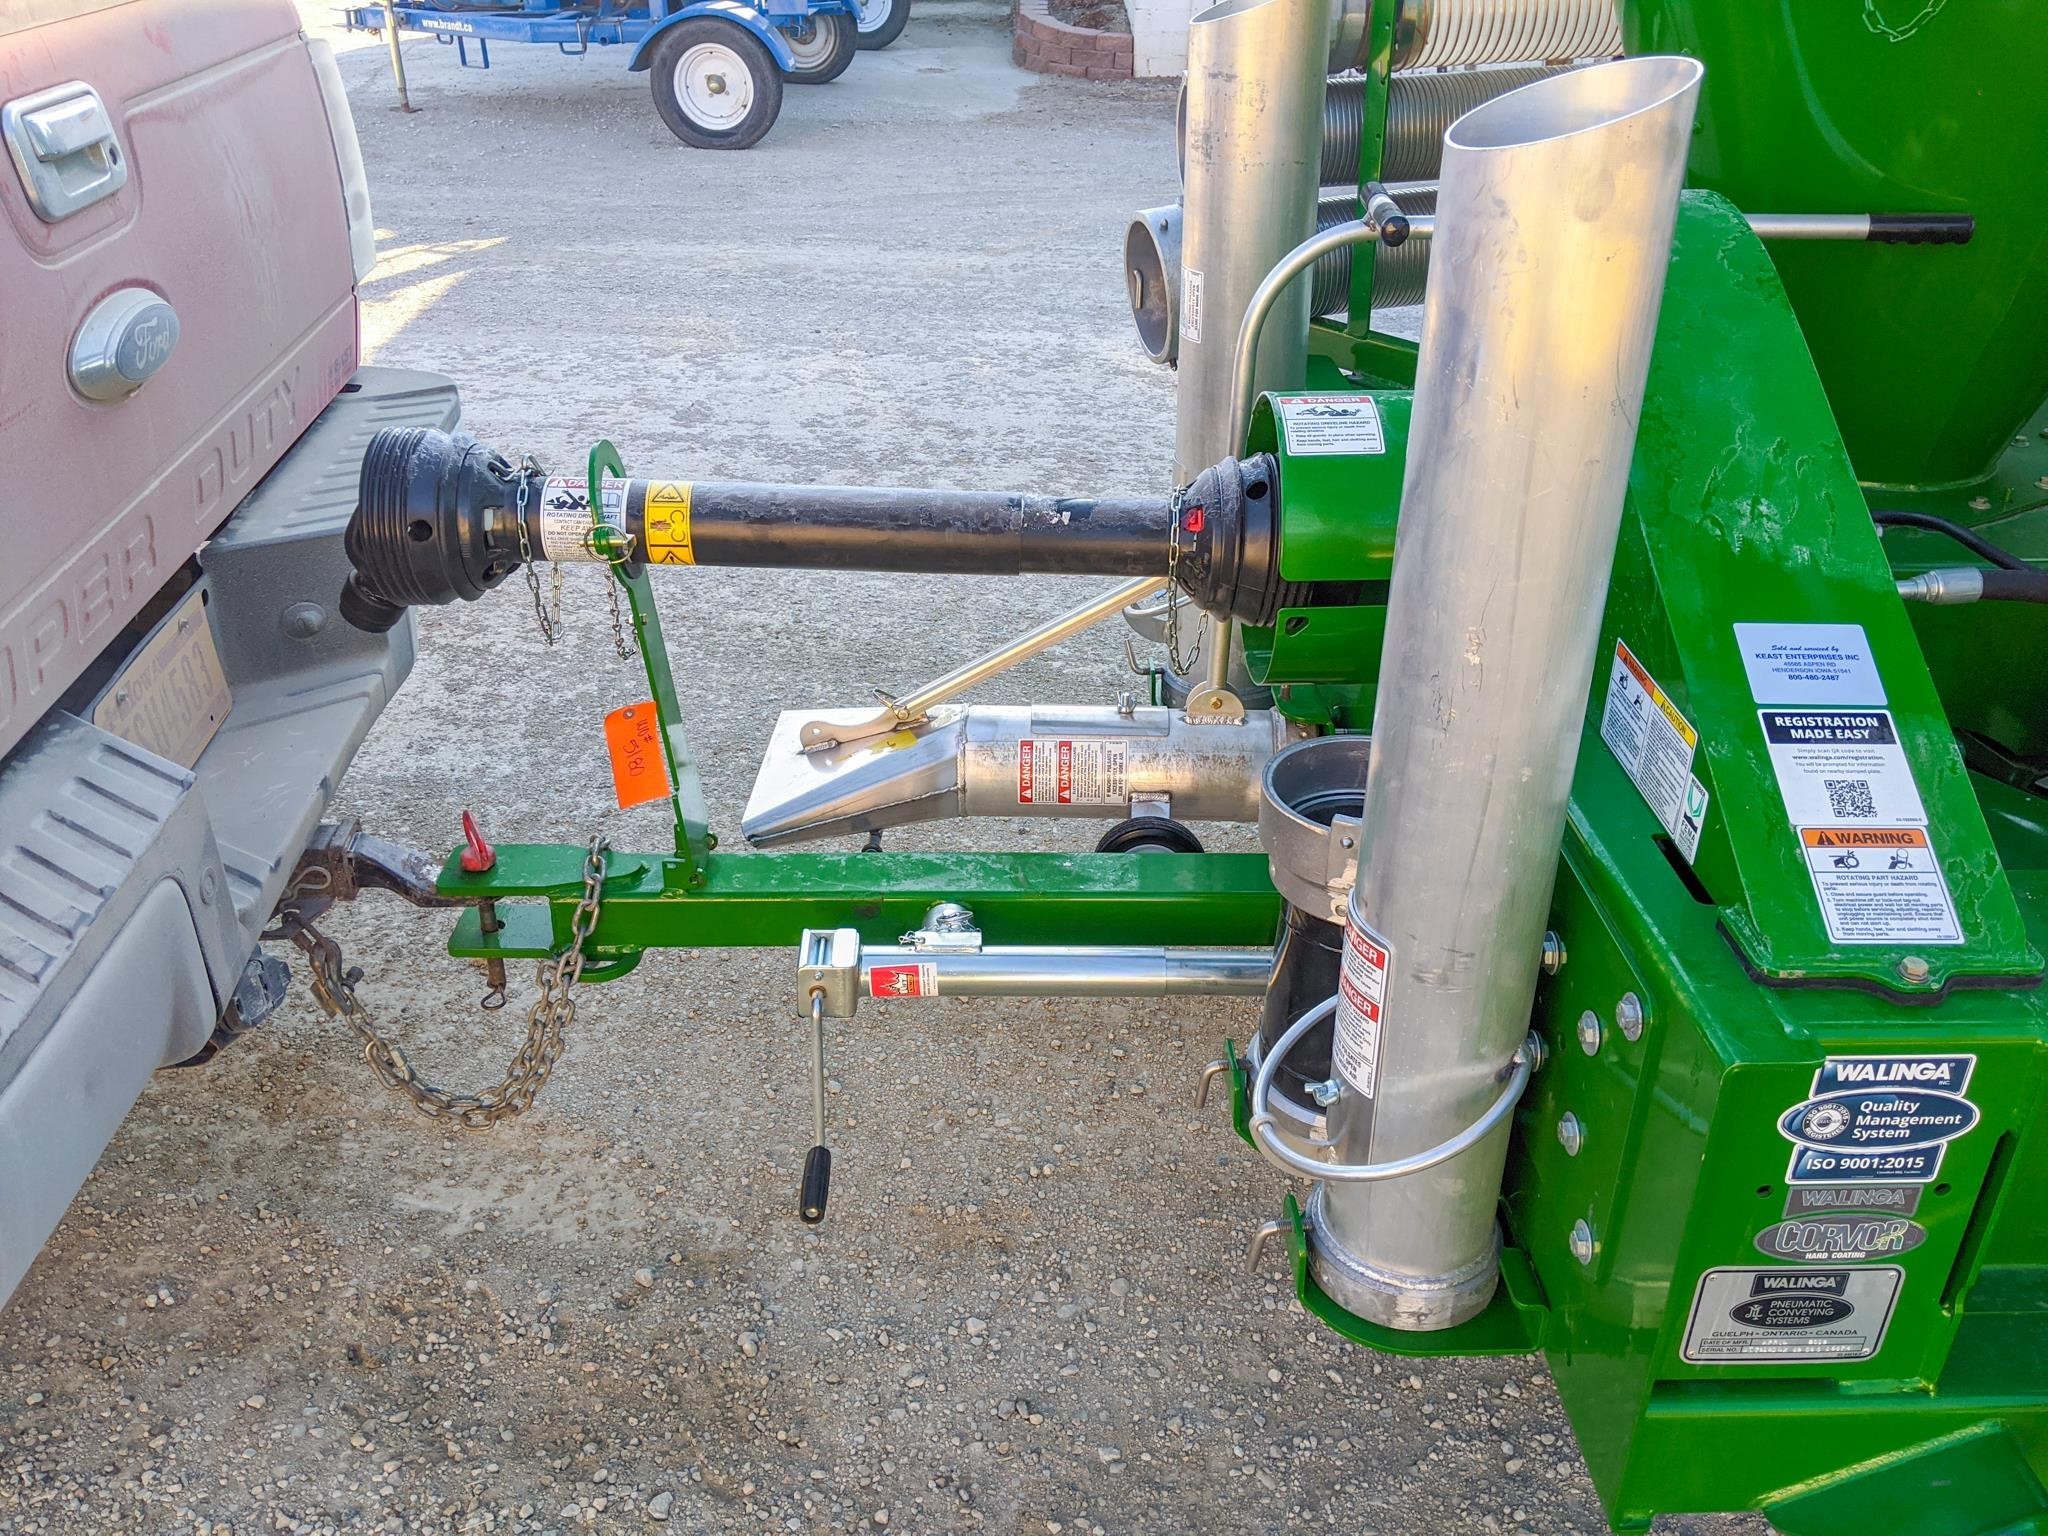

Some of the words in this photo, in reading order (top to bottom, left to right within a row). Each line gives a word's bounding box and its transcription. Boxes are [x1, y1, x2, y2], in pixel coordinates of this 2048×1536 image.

[421, 17, 473, 33] www.brandt.ca
[134, 316, 170, 370] Ford
[193, 366, 300, 525] DUTY
[1665, 702, 1687, 735] CAUTION
[1774, 716, 1879, 727] REGISTRATION
[1790, 729, 1833, 739] MADE
[1836, 729, 1870, 739] EASY
[1022, 745, 1032, 787] DANGER
[1061, 745, 1070, 787] DANGER
[1681, 819, 1696, 841] FEMA
[1835, 833, 1914, 844] WARNING
[1346, 920, 1378, 963] DANGER
[1341, 978, 1372, 1015] DANGER
[1836, 1062, 1951, 1081] WALINGA
[1860, 1101, 1920, 1113] Quality
[1856, 1115, 1962, 1128] Management
[1851, 1128, 1910, 1141] System
[1806, 1158, 1836, 1170] ISO
[1839, 1157, 1925, 1169] 9001:2015
[1801, 1189, 1906, 1206] WALINGA
[1775, 1219, 1909, 1252] CORVOR
[1763, 1277, 1837, 1289] WALINGA
[1768, 1308, 1835, 1316] CONVEYING
[1770, 1300, 1832, 1308] PNEUMATIC
[1765, 1317, 1810, 1325] SYSTEMS
